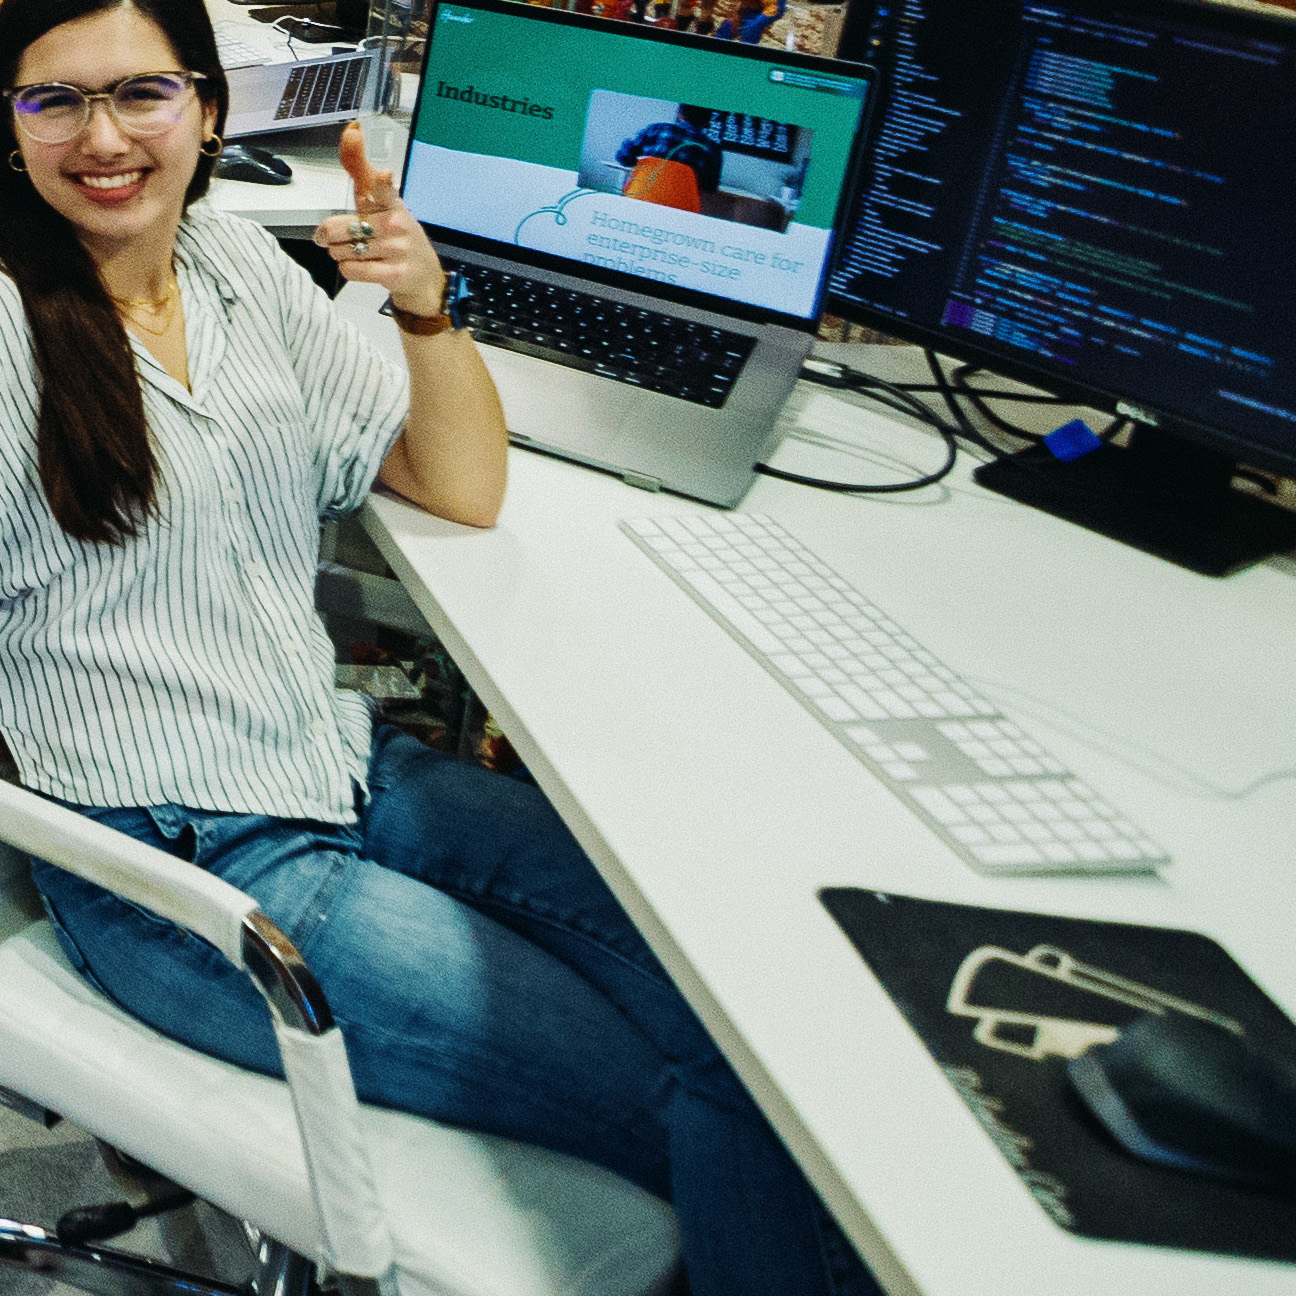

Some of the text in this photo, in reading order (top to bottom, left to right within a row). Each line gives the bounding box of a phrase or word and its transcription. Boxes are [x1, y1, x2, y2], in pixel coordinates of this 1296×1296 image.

[436, 81, 555, 120] Industries
[587, 232, 742, 281] enterprise-size
[590, 210, 804, 273] Homegrown care for
[583, 252, 679, 284] problems
